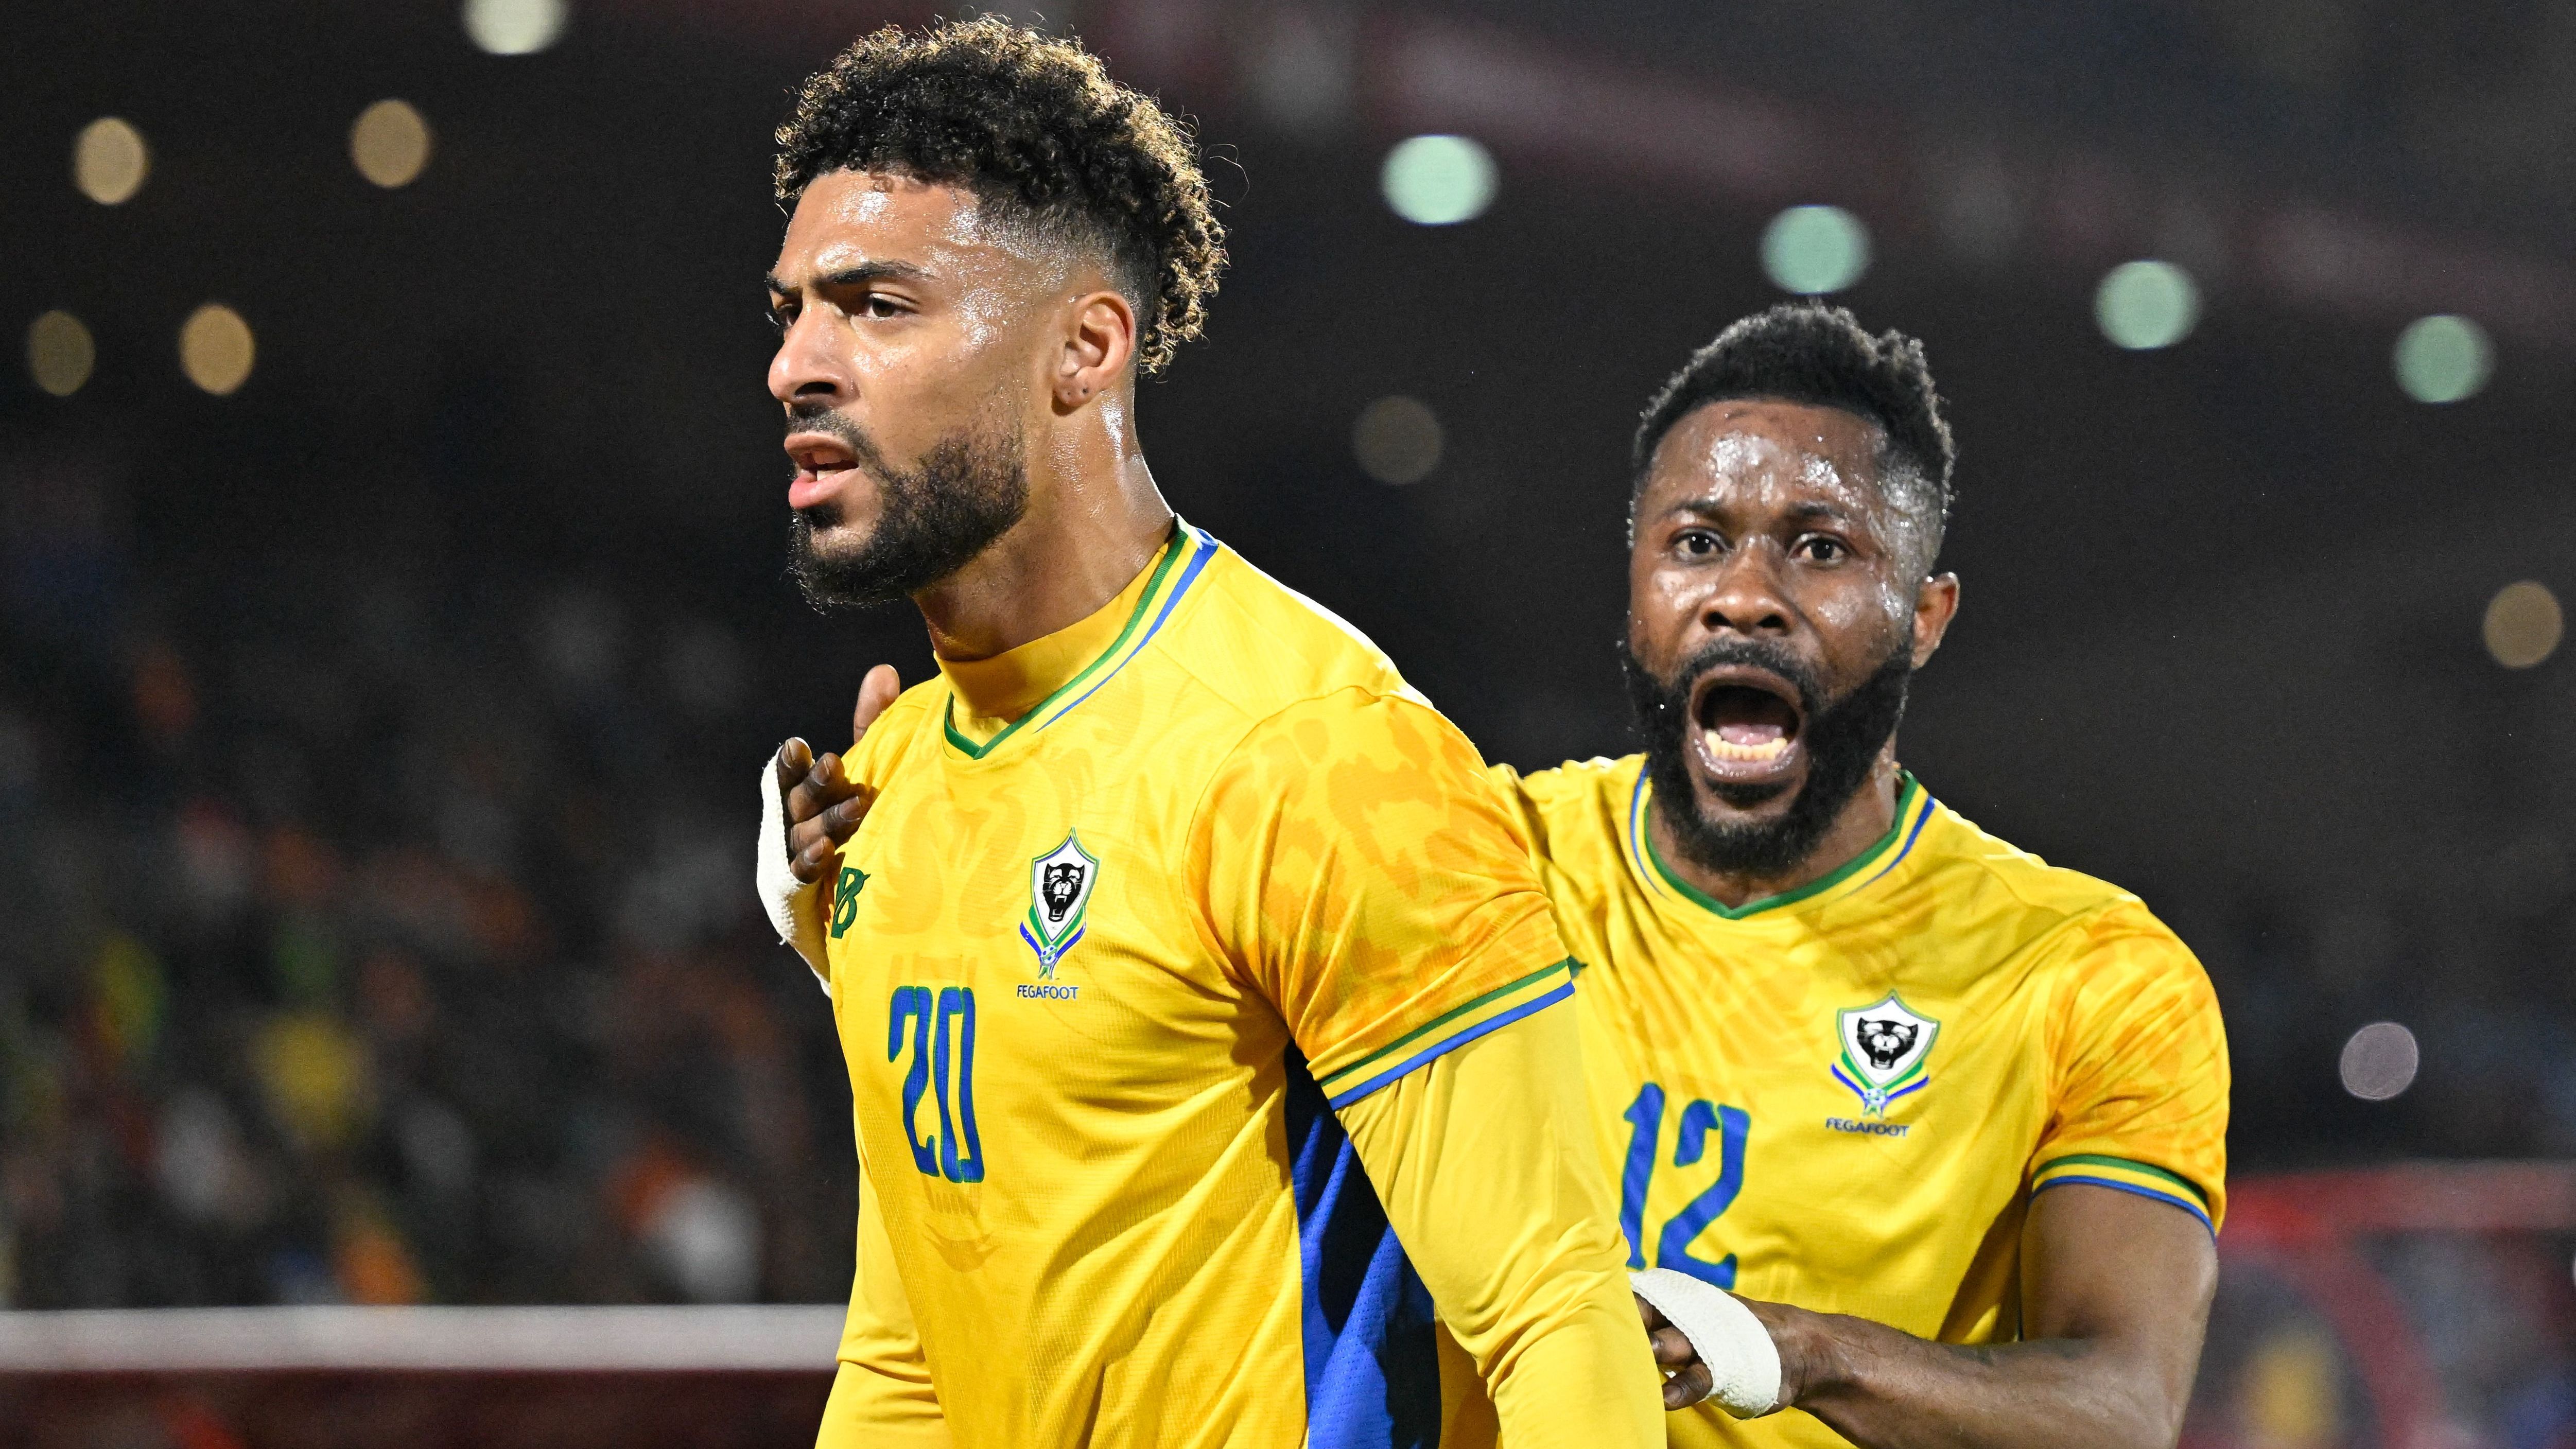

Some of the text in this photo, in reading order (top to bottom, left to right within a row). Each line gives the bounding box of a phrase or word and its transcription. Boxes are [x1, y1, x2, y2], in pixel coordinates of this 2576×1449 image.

[1017, 984, 1079, 999] FEGAFOOT
[887, 985, 985, 1183] 20
[1826, 1118, 1909, 1137] FEGAFOOT
[1619, 1081, 1751, 1290] 12
